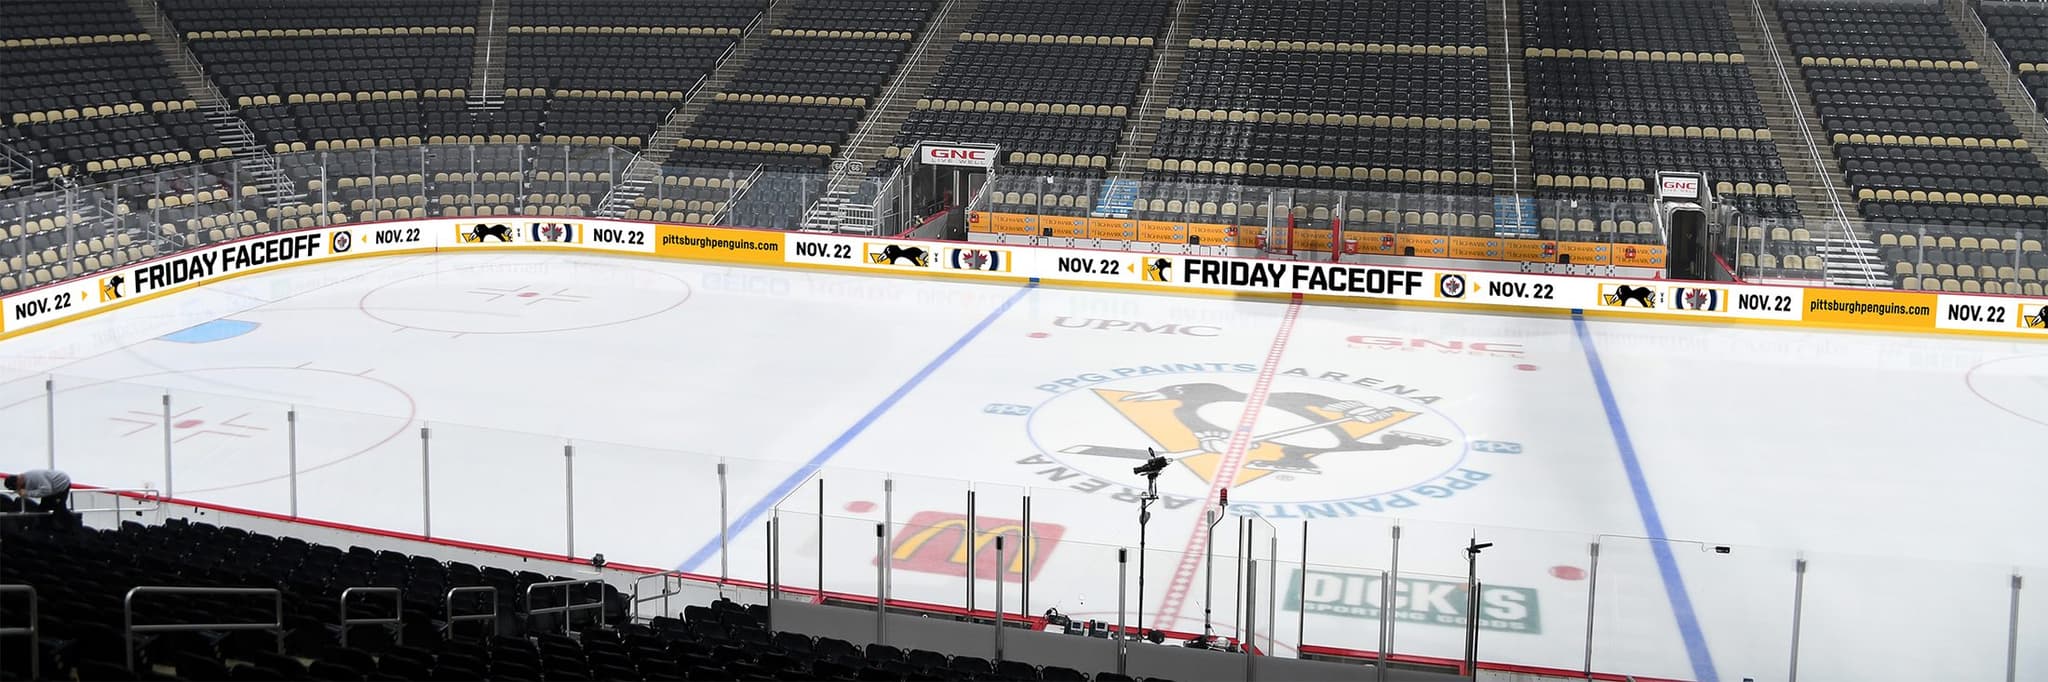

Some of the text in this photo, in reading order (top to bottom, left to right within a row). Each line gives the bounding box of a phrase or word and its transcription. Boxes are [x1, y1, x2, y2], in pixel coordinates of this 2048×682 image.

[931, 148, 986, 161] GNC
[1663, 181, 1697, 190] GNC
[376, 228, 420, 244] NOV. 22
[593, 229, 644, 244] NOV. 22
[662, 235, 778, 251] pittsburghpenguins.com
[796, 242, 851, 259] NOV. 22
[135, 234, 320, 293] FRIDAY FACEOFF
[1058, 257, 1119, 275] NOV. 22
[1184, 258, 1423, 296] FRIDAY FACEOFF
[1489, 281, 1554, 299] NOV. 22
[16, 292, 71, 320] NOV. 22
[1739, 294, 1792, 312] NOV. 22
[1810, 299, 1931, 316] pittsburghpenguins.com
[1949, 305, 2006, 323] NOV. 22
[1052, 316, 1222, 337] UPMC
[1346, 335, 1524, 354] GNC
[1035, 362, 1443, 405] PPG PAINTS ARENA
[1015, 454, 1492, 519] PPG PAINTS ARENA
